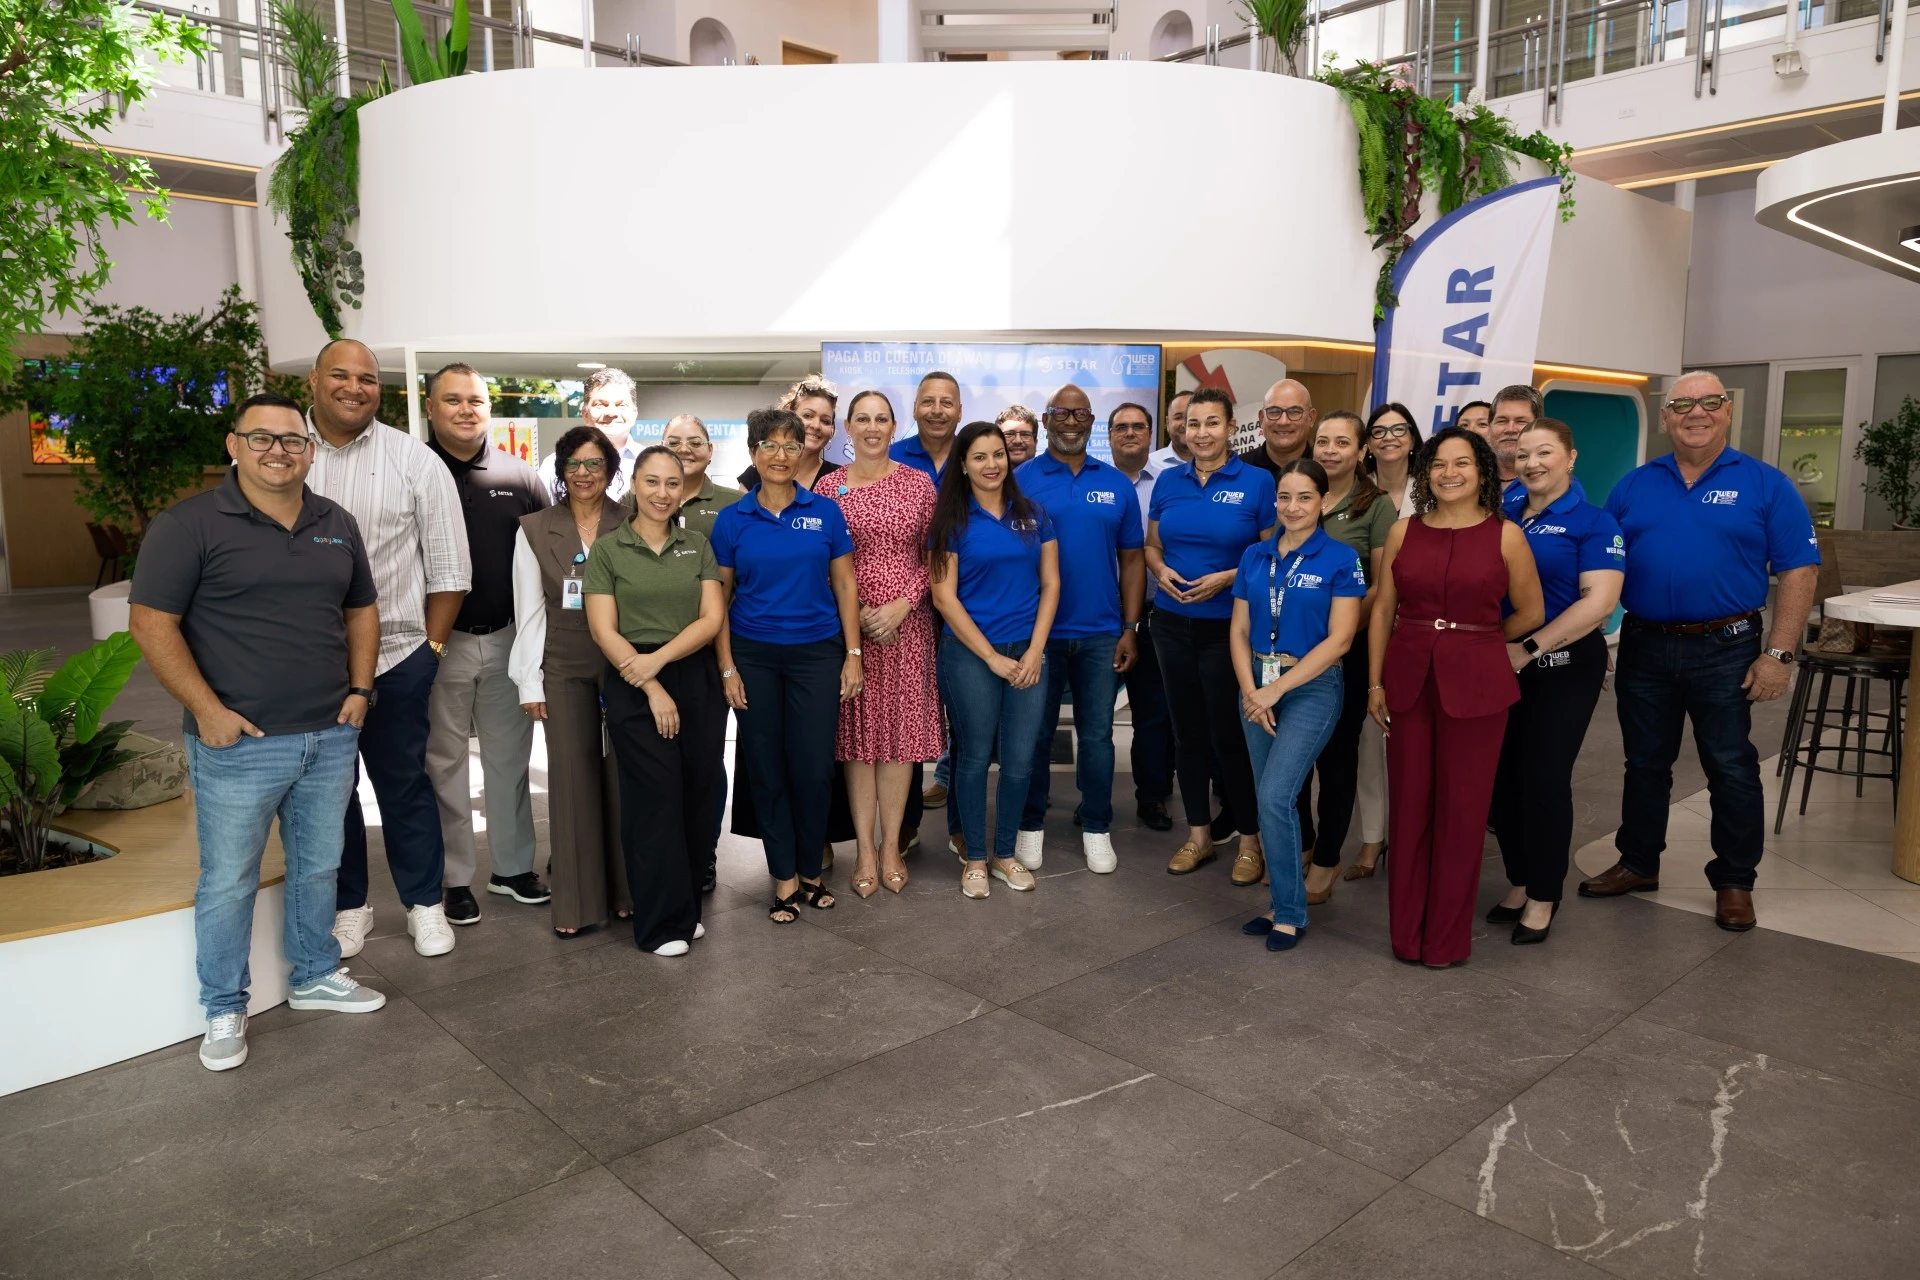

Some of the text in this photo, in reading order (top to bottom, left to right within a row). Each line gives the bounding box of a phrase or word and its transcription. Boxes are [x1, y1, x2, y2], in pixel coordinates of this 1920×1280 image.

[1432, 265, 1495, 434] ETAR
[827, 350, 860, 363] PAGA
[864, 350, 881, 363] BO
[885, 350, 934, 364] CUENTA
[1132, 354, 1155, 364] WEB
[1057, 360, 1097, 370] SETAR
[839, 366, 863, 375] KIOSK
[888, 366, 926, 375] TELESHOP
[705, 423, 737, 436] ENTA
[1092, 424, 1108, 432] FACI
[1227, 491, 1245, 499] WEB
[806, 517, 823, 525] WEB
[1302, 573, 1322, 583] WEB
[1552, 651, 1570, 659] WEB
